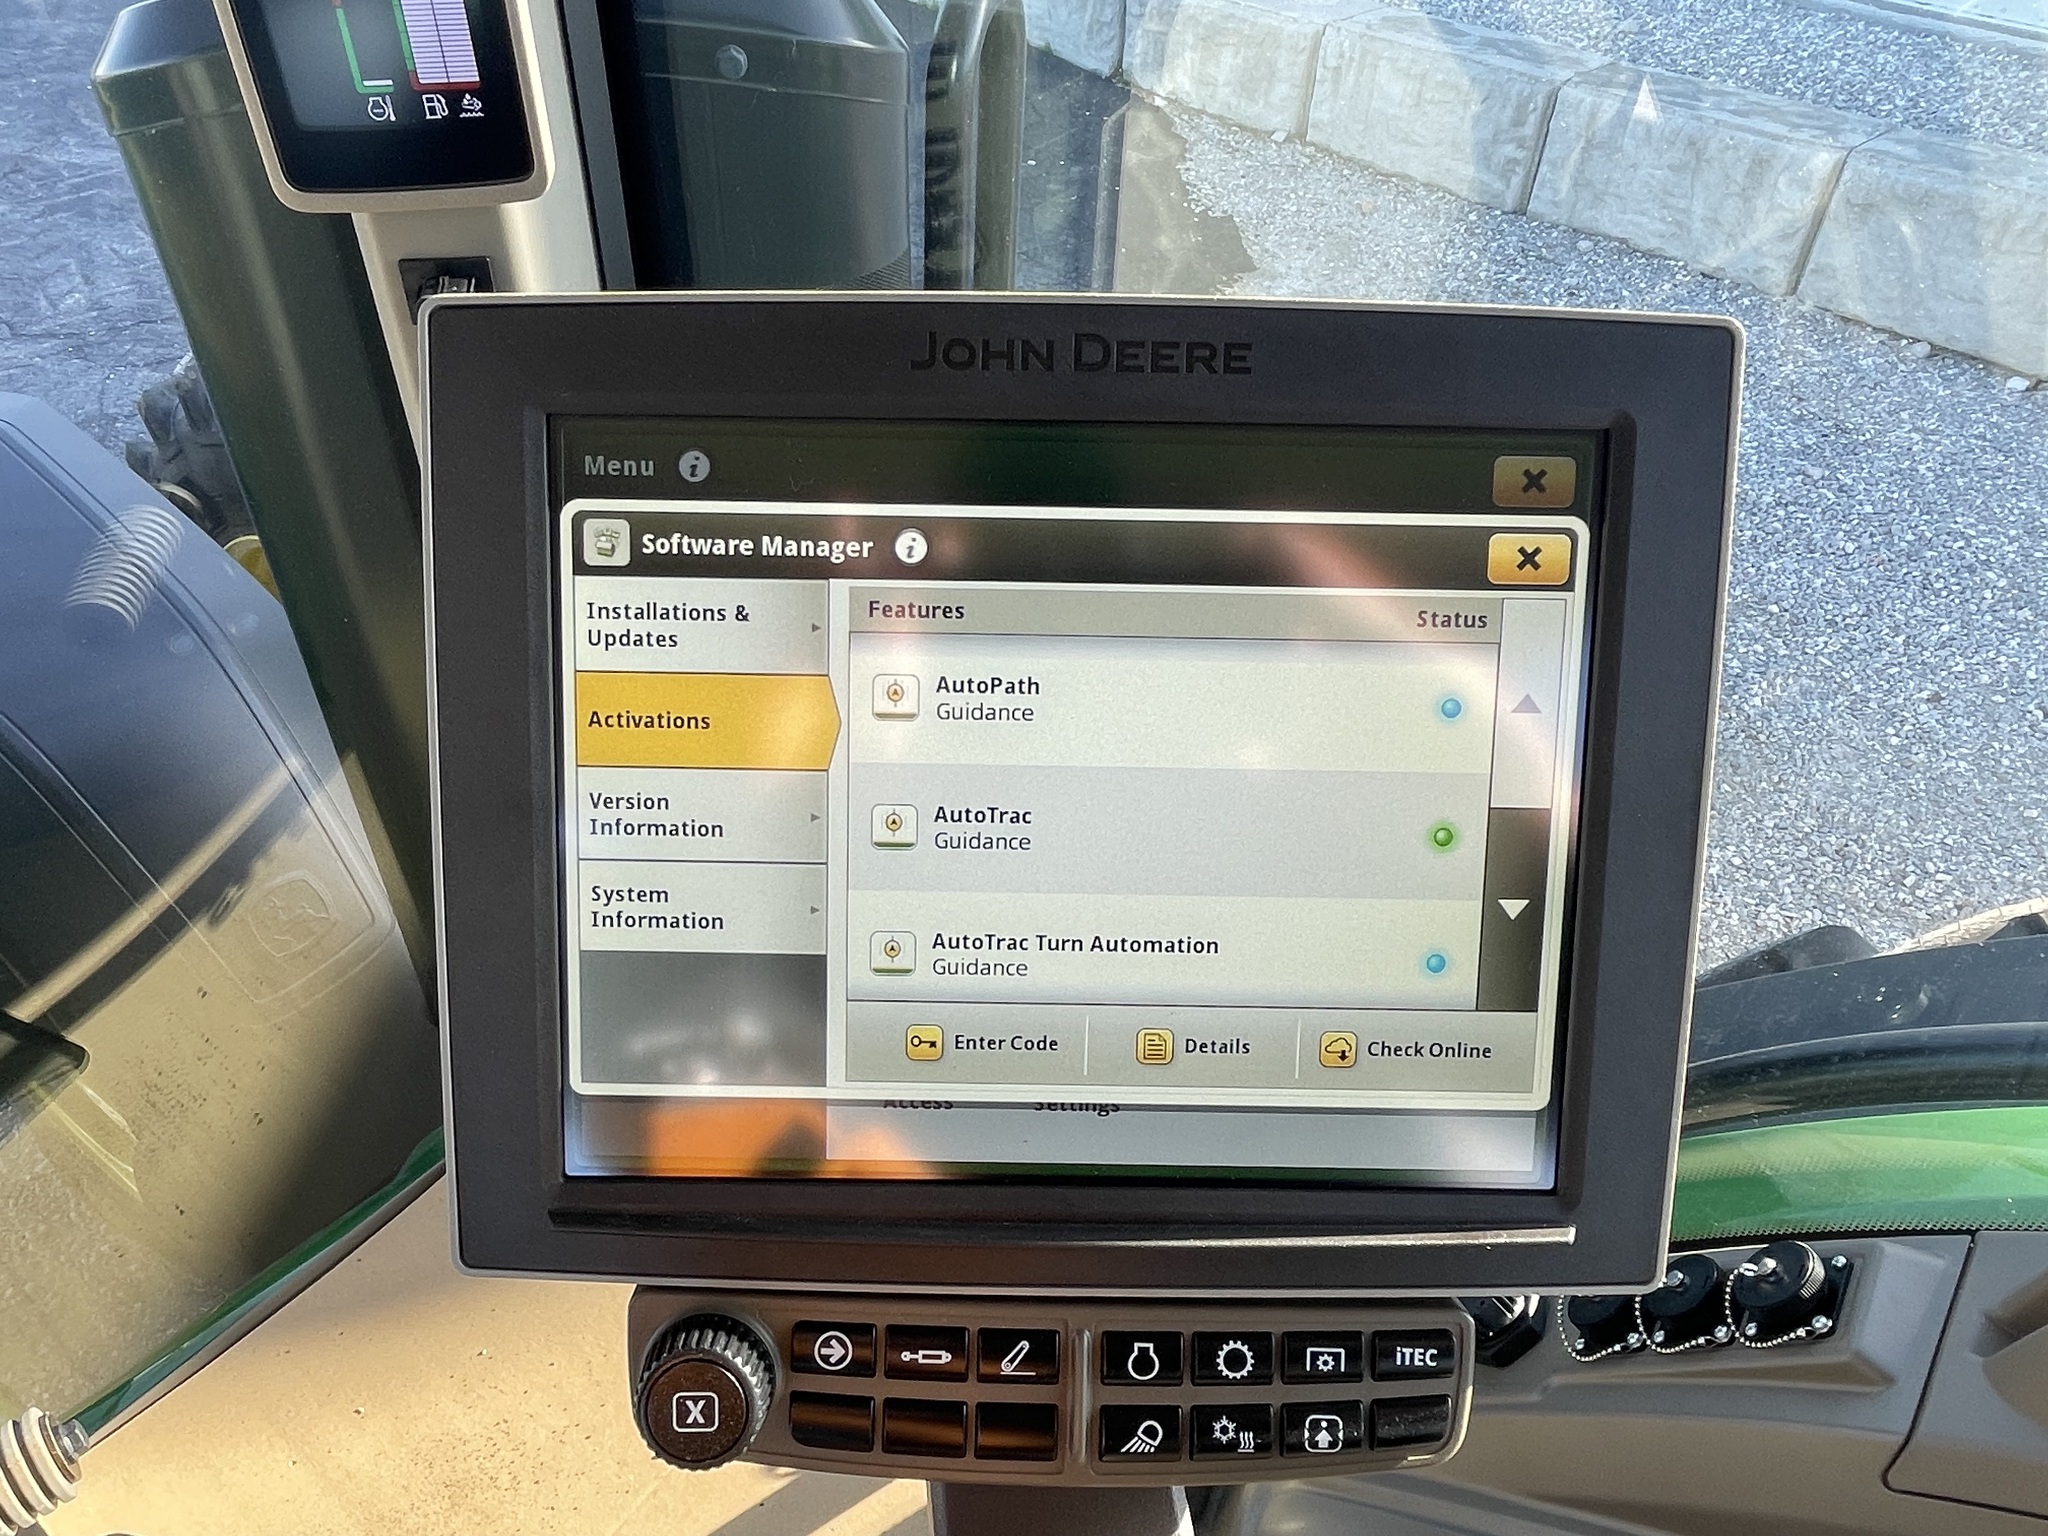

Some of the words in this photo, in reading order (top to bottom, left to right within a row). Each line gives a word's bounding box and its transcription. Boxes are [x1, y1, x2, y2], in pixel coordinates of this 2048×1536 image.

[910, 331, 1055, 371] JOHN
[1073, 332, 1253, 375] DEERE
[584, 455, 655, 477] Menu
[642, 533, 755, 557] Software
[762, 535, 874, 563] Manager
[587, 602, 727, 622] Installations
[735, 604, 750, 622] &
[869, 600, 965, 620] Features
[1417, 610, 1488, 629] Status
[588, 629, 678, 650] Updates
[936, 675, 1040, 696] AutoPath
[588, 710, 711, 731] Activations
[937, 702, 1035, 723] Guidance
[589, 792, 669, 811] Version
[934, 806, 1032, 826] AutoTrac
[590, 818, 724, 838] Information
[934, 831, 1032, 851] Guidance
[591, 886, 669, 905] System
[591, 911, 724, 931] Information
[932, 933, 1029, 953] AutoTrac
[1036, 935, 1084, 953] Turn
[1090, 935, 1219, 955] Automation
[932, 957, 1028, 978] Guidance
[954, 1035, 1005, 1053] Enter
[1011, 1035, 1058, 1053] Code
[1185, 1037, 1251, 1056] Details
[1367, 1041, 1423, 1060] Check
[1430, 1042, 1492, 1062] Online
[1396, 1345, 1438, 1367] iTEC
